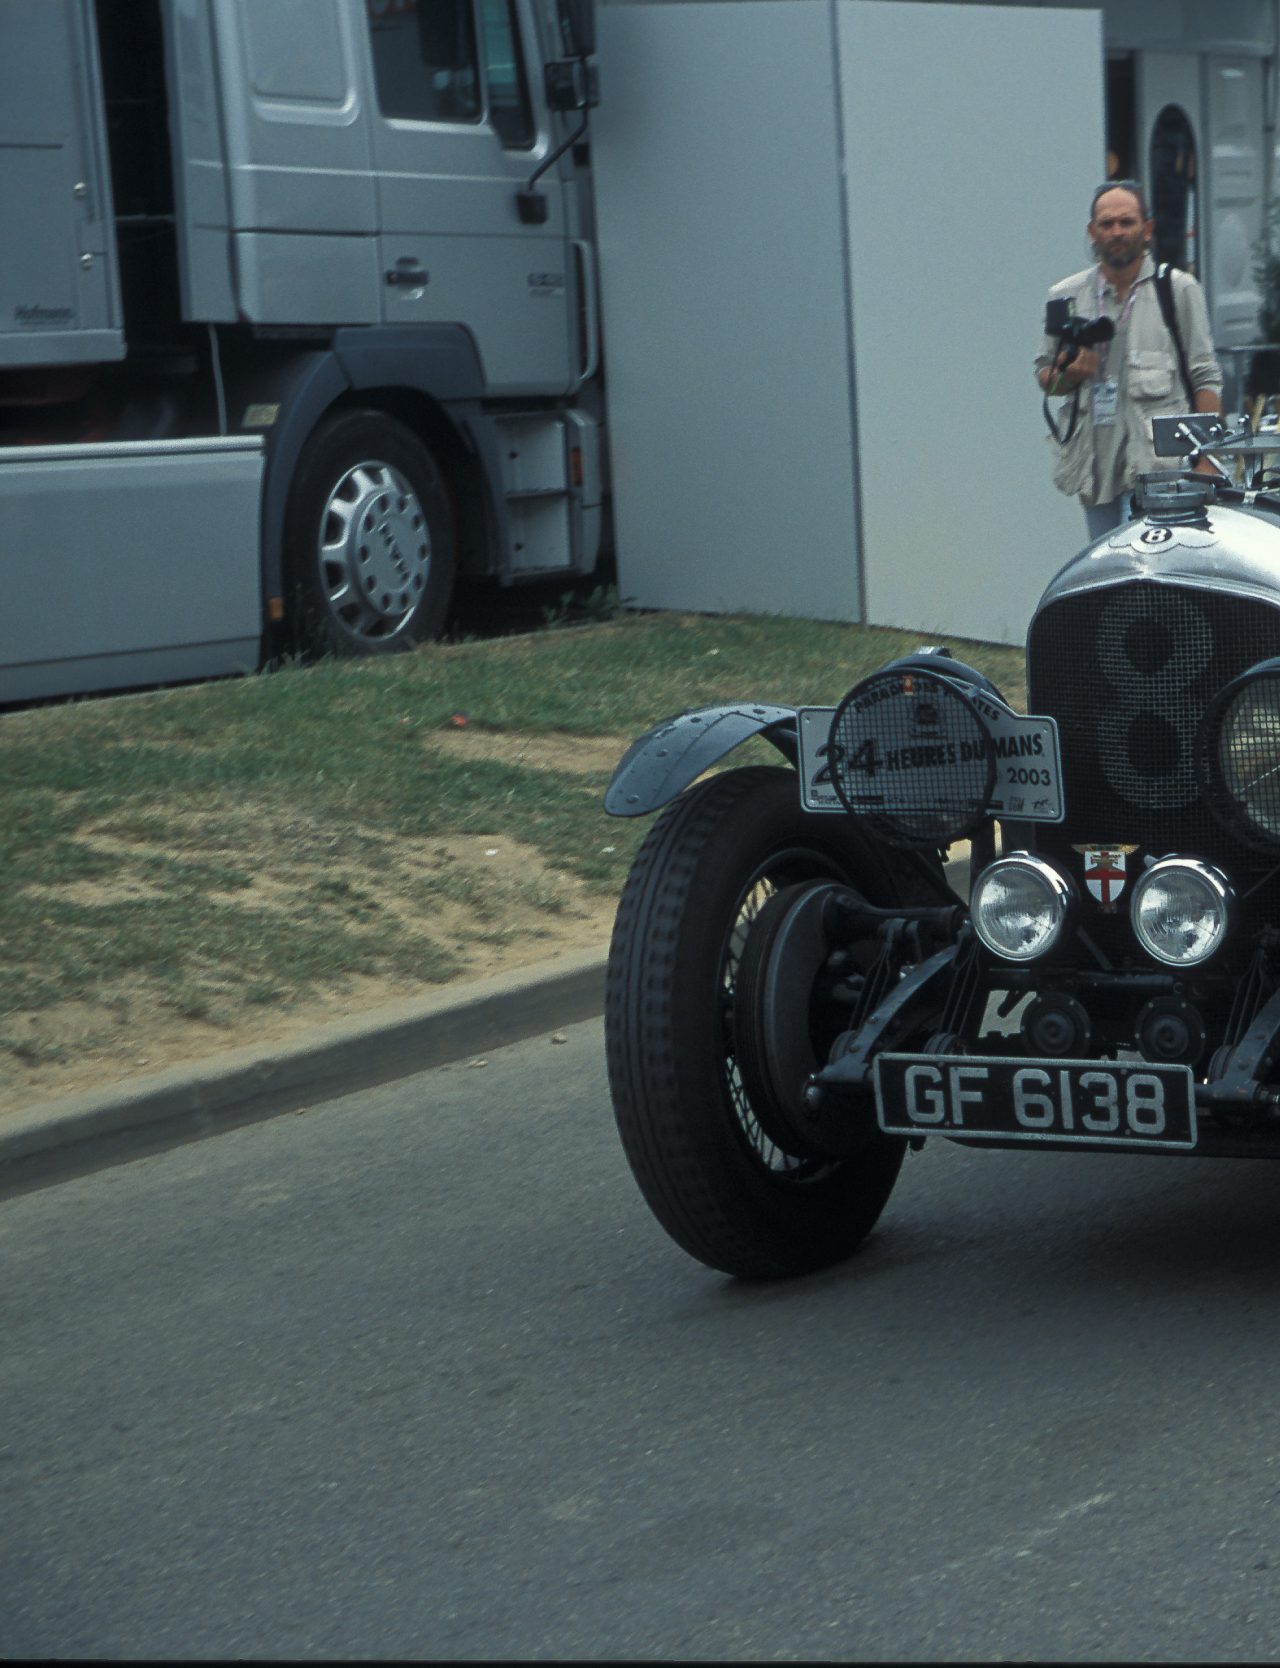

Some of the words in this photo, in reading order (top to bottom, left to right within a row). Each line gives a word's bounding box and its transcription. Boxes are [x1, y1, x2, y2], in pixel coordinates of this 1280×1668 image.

[1097, 589, 1214, 808] 8
[811, 739, 882, 785] 24
[887, 745, 956, 771] HEURES
[991, 733, 1042, 760] MANS
[1007, 767, 1050, 786] 2003
[904, 1064, 989, 1125] GF
[1012, 1067, 1166, 1135] 6138
